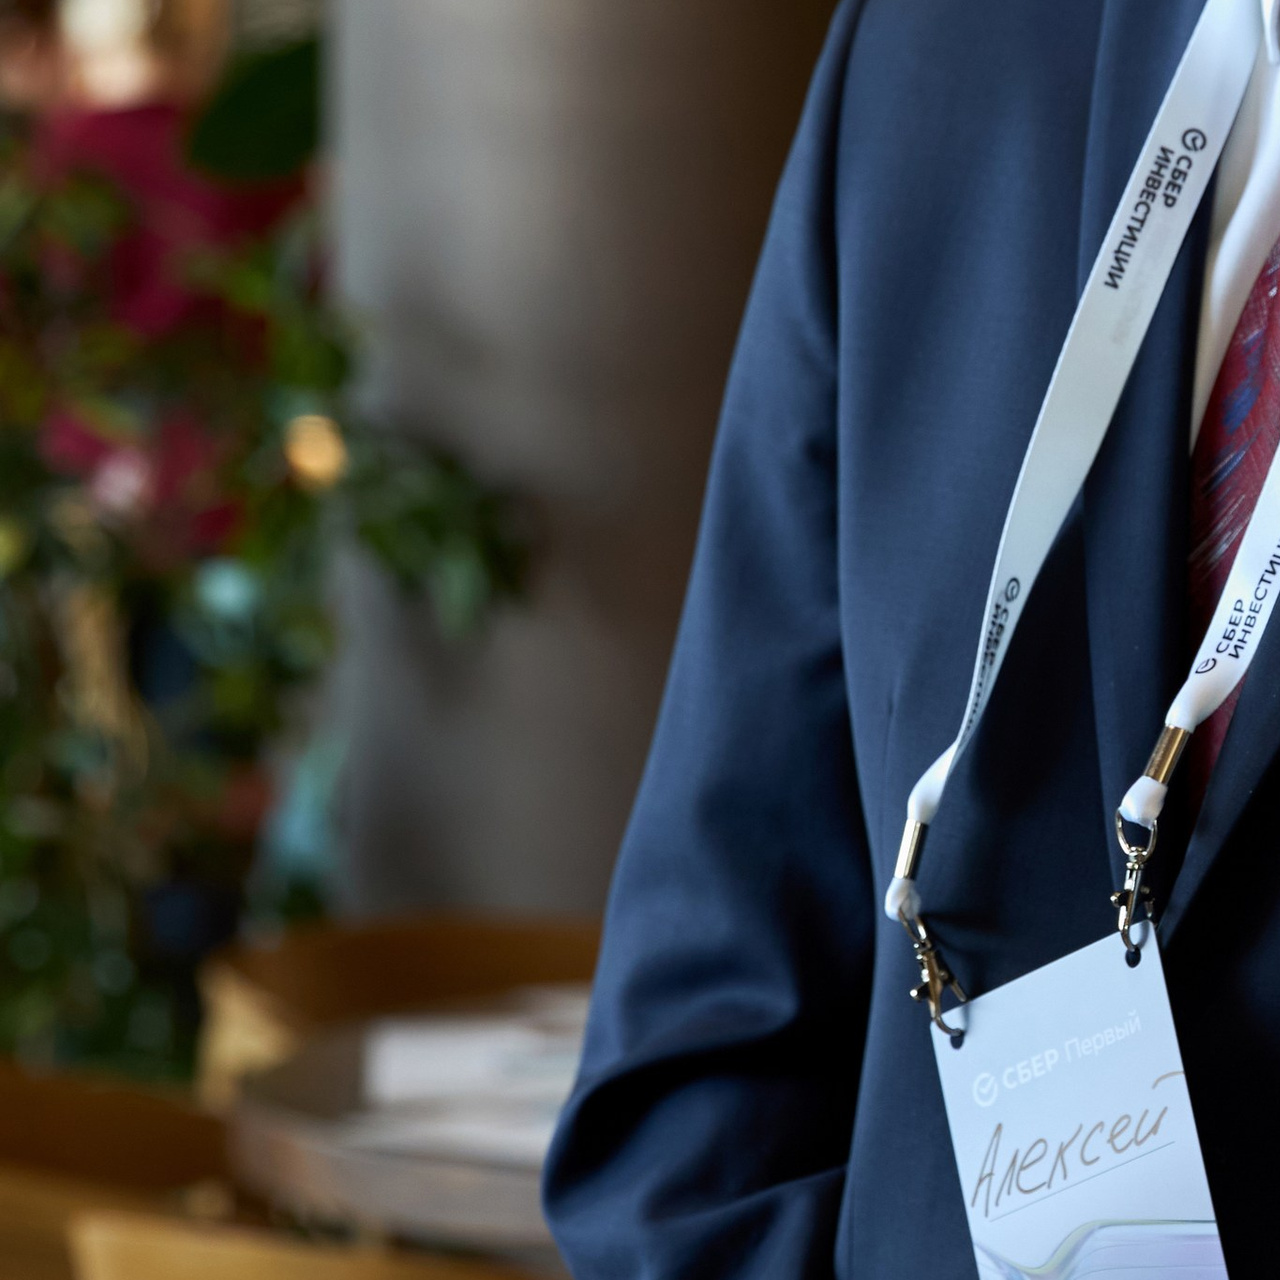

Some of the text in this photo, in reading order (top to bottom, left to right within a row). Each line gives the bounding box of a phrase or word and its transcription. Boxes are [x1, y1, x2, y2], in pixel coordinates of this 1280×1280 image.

[1104, 145, 1175, 290] ИНВЕСТИЦИИ
[1162, 154, 1193, 209] СБЕР
[1216, 598, 1246, 654] СБЕР
[1002, 1010, 1142, 1089] СБЕР Первый
[971, 1070, 1185, 1218] Алексей
